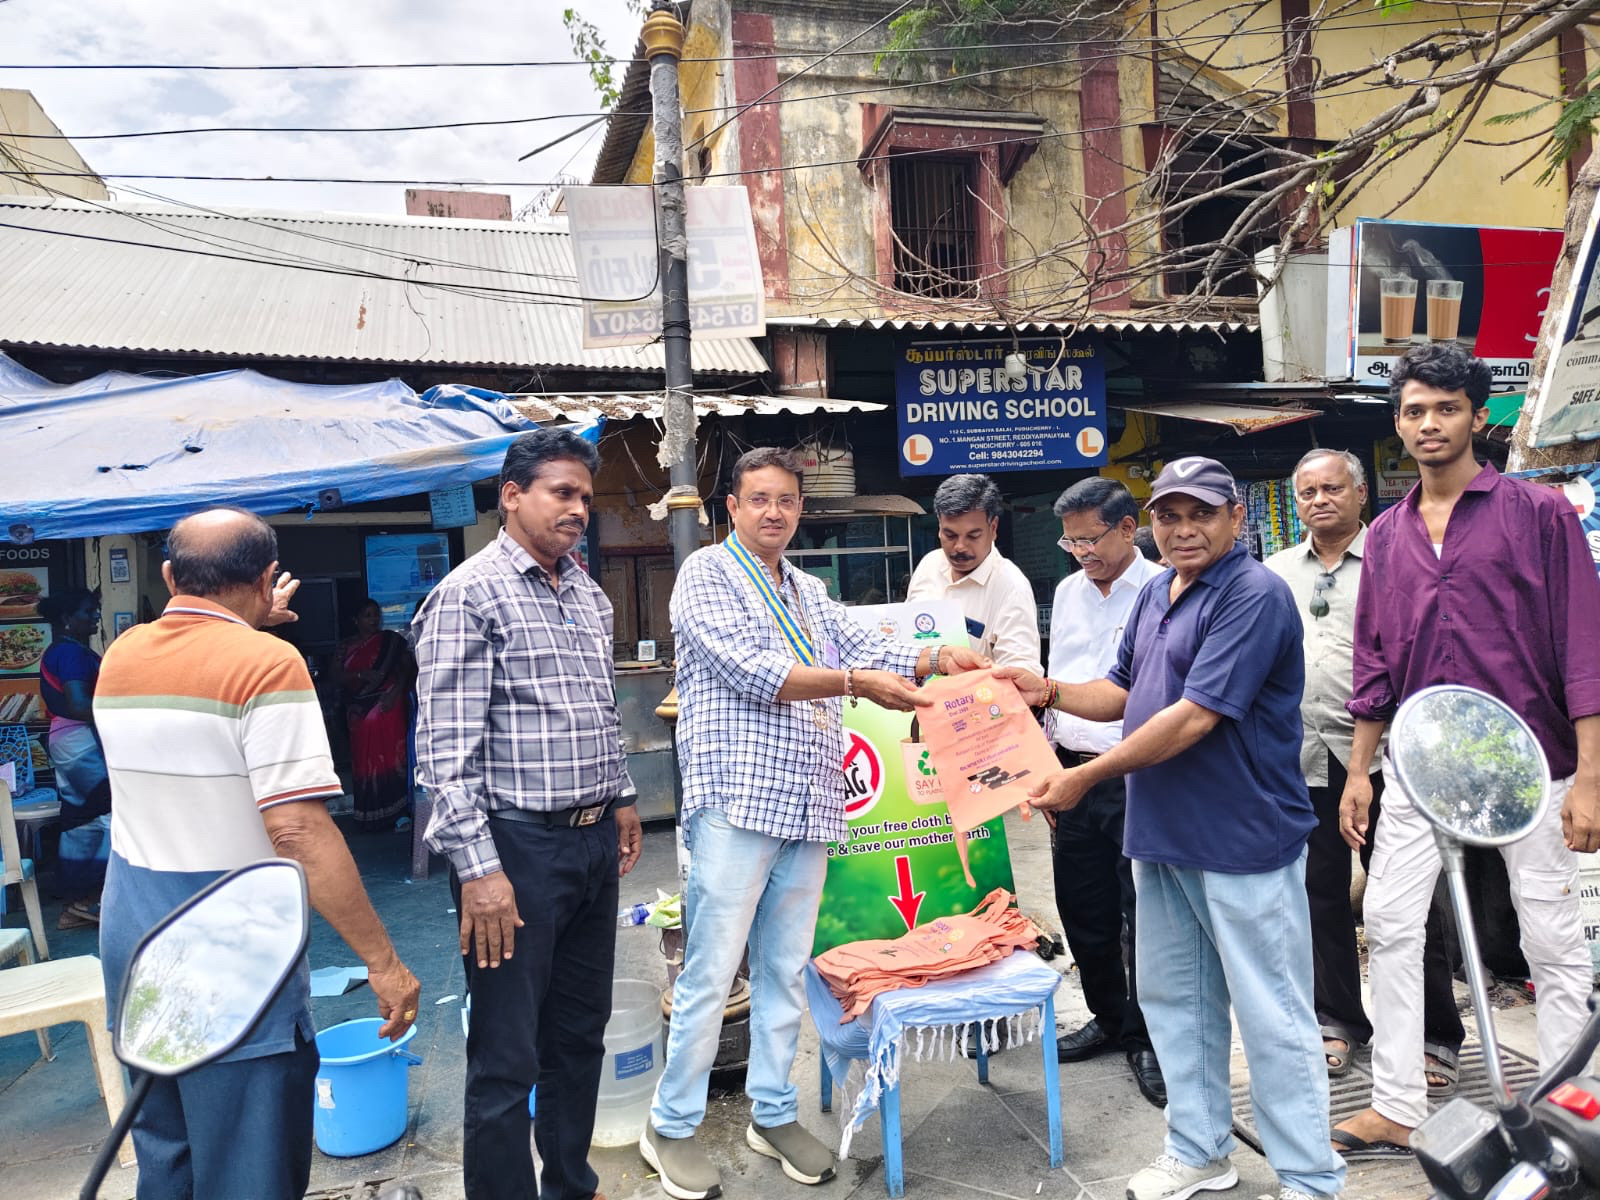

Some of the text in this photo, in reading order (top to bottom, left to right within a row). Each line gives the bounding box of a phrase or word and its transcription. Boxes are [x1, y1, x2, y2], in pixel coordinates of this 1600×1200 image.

[920, 365, 1083, 395] SUPERSTAR
[1570, 389, 1595, 406] SAFE
[907, 397, 1096, 423] DRIVING SCHOOL
[909, 438, 927, 461] L
[1081, 431, 1099, 453] L
[969, 449, 1044, 460] Cell: 9843042294
[944, 694, 974, 710] Rotary
[844, 766, 867, 800] AG
[915, 779, 934, 790] SAY
[852, 825, 880, 838] your
[884, 821, 908, 832] free
[911, 816, 941, 829] cloth
[838, 843, 849, 855] &
[852, 842, 880, 853] save
[884, 840, 905, 849] our
[909, 833, 953, 847] mother
[966, 827, 989, 839] arth
[1580, 885, 1600, 898] nit
[1584, 925, 1600, 941] AF
